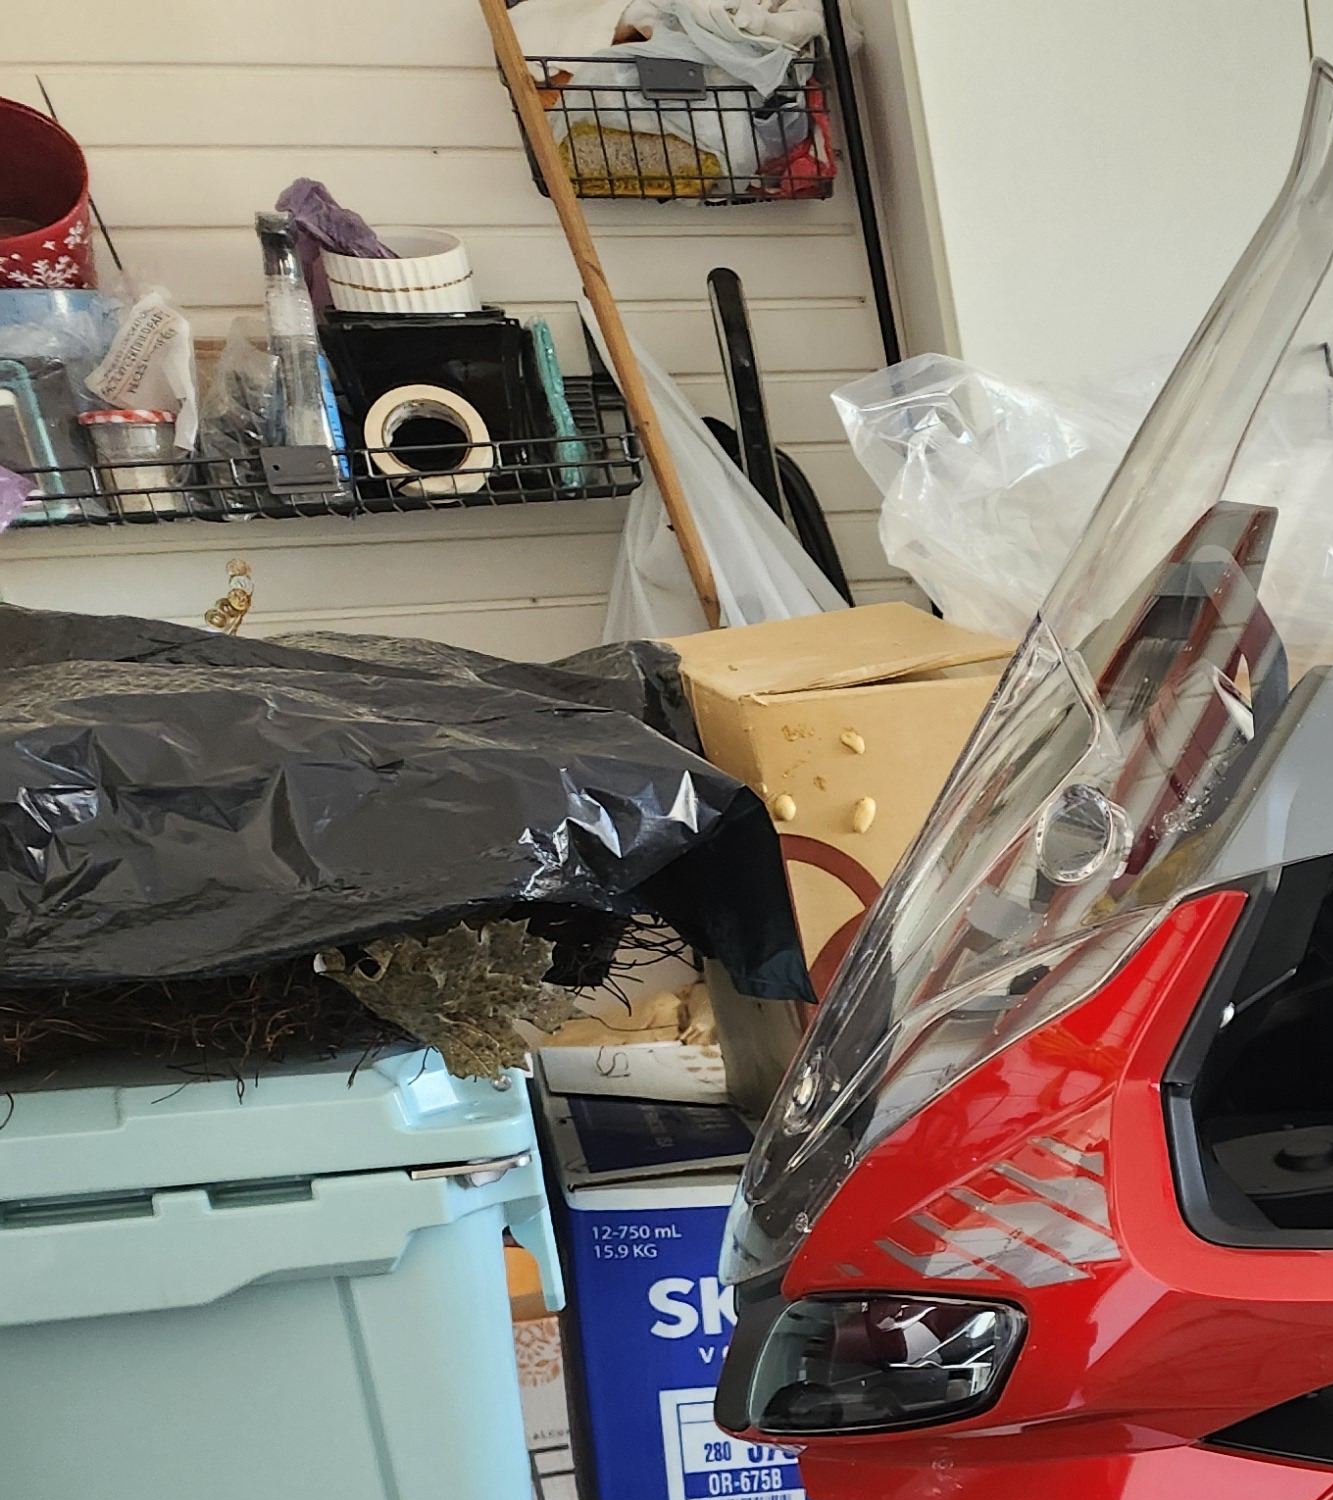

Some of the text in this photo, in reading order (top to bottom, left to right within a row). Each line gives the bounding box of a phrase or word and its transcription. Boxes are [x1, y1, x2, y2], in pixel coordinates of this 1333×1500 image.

[592, 1224, 682, 1240] 12-750 mL
[594, 1243, 658, 1259] 15.9 KG
[649, 1276, 738, 1339] SK
[704, 1441, 732, 1463] 280
[708, 1468, 782, 1495] OR-675B
